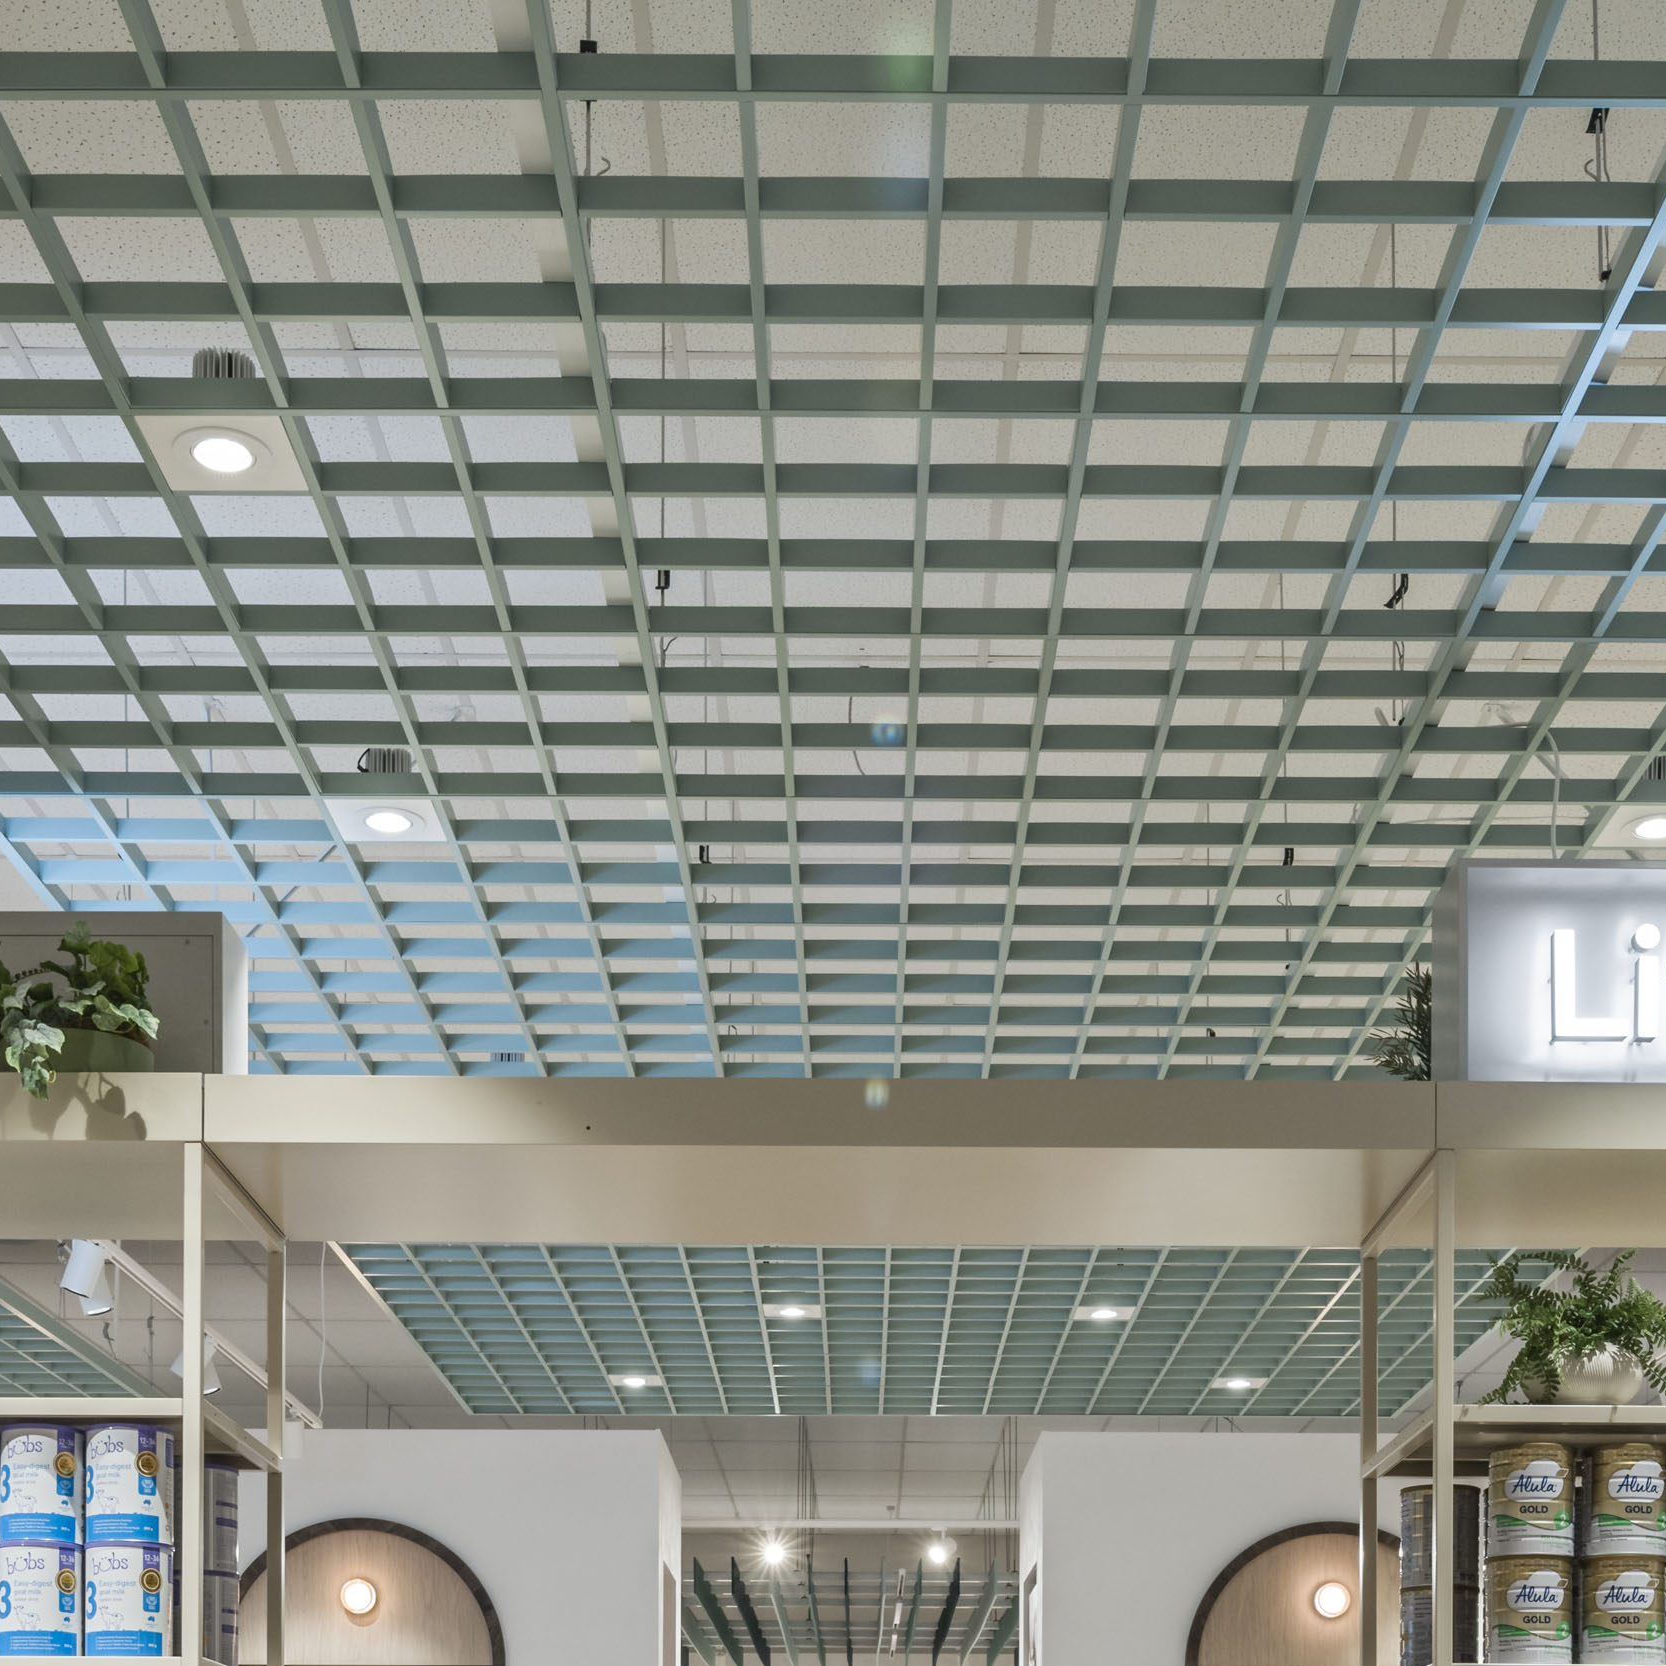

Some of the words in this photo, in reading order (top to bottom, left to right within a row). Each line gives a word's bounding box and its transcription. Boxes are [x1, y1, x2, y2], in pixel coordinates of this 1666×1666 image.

[1513, 1474, 1557, 1493] Alula
[1617, 1475, 1659, 1494] Alula
[1520, 1505, 1548, 1514] GOLD
[1625, 1505, 1652, 1514] GOLD
[1514, 1585, 1559, 1604] Alula
[1603, 1585, 1647, 1604] Alula
[1523, 1615, 1551, 1624] GOLD
[1611, 1616, 1640, 1625] GOLD
